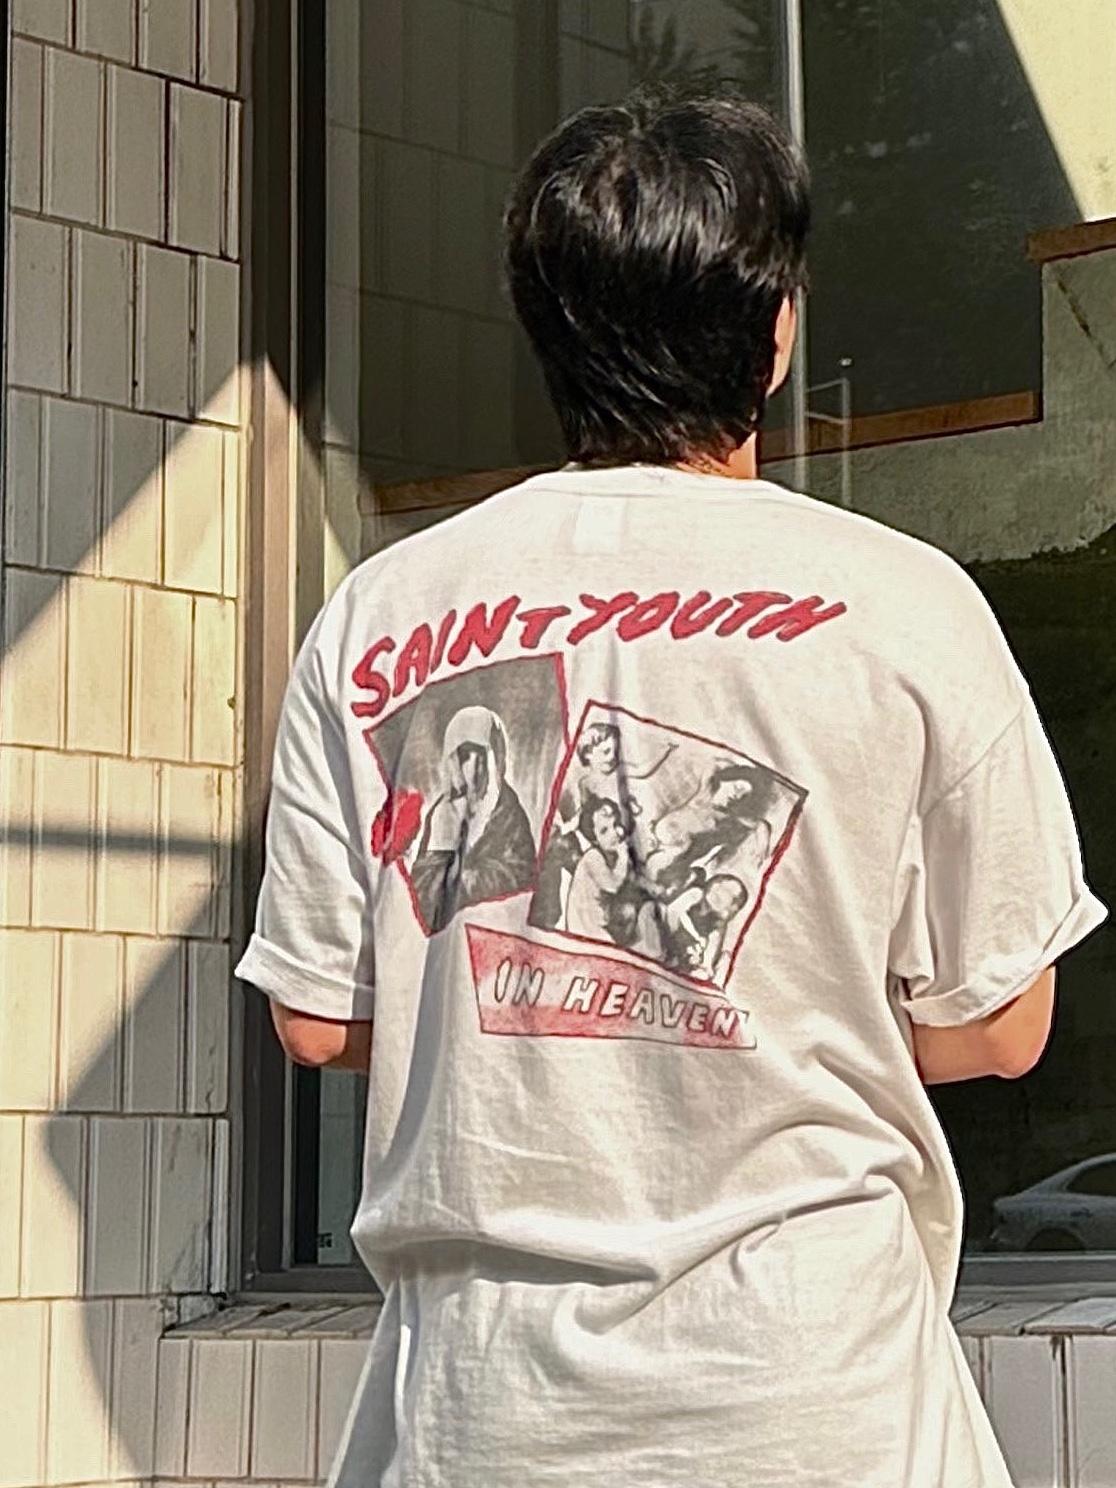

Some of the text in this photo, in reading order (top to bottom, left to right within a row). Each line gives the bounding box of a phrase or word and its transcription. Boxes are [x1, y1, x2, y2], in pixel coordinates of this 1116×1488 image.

[351, 591, 847, 717] SAINT YOUTH
[494, 956, 740, 1039] IN HEAVEN
